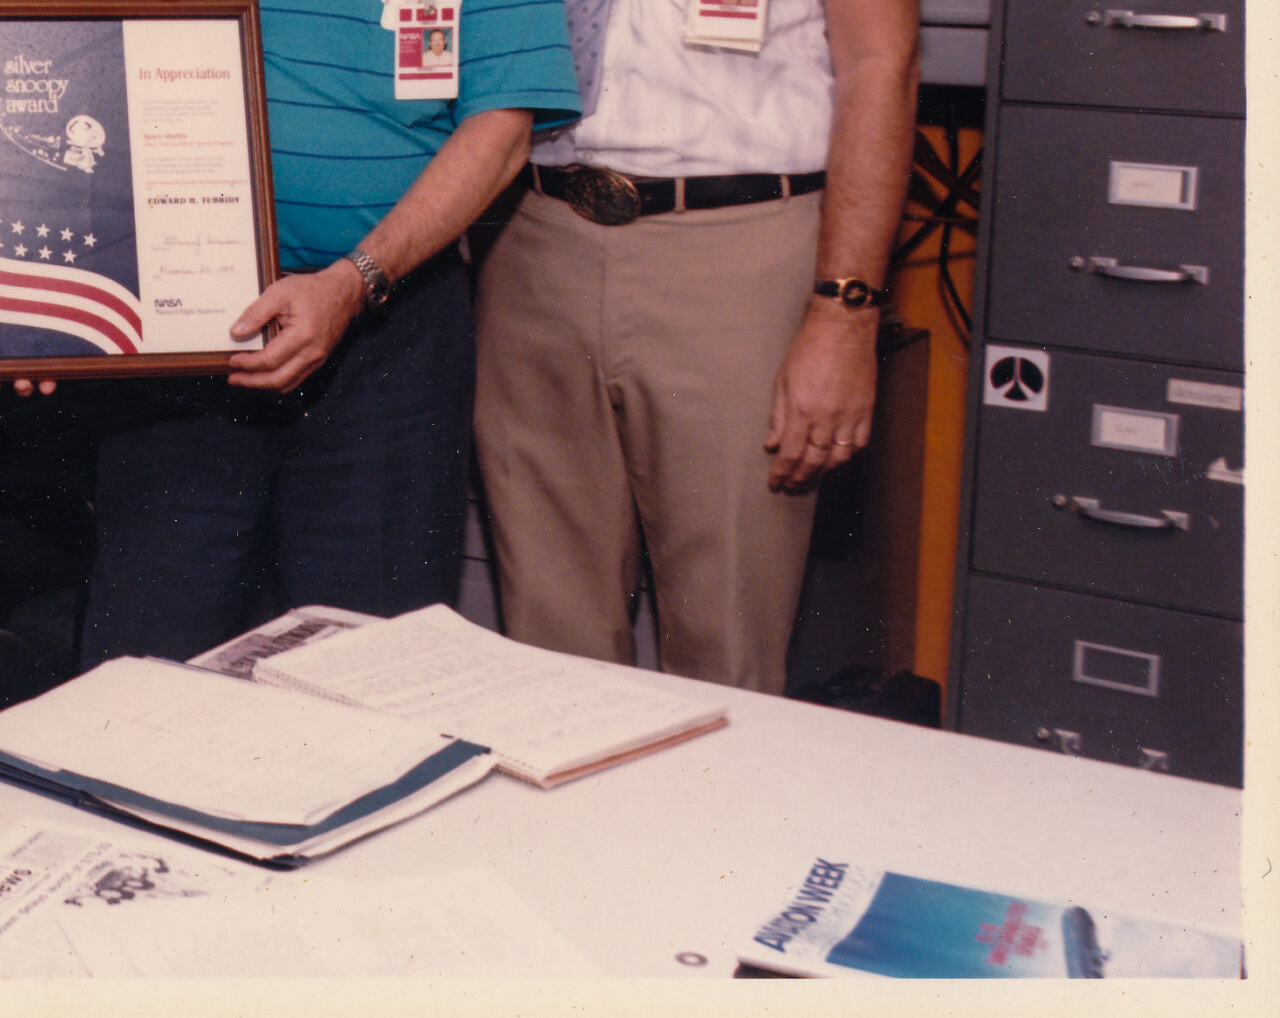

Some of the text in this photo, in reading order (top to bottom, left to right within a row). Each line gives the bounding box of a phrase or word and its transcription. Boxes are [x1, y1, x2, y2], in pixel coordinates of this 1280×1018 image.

[4, 53, 53, 74] silver
[138, 66, 231, 83] In Appreciation
[5, 78, 69, 100] snoopy
[6, 93, 58, 114] award
[154, 298, 183, 308] NASA
[796, 856, 849, 902] WEEK
